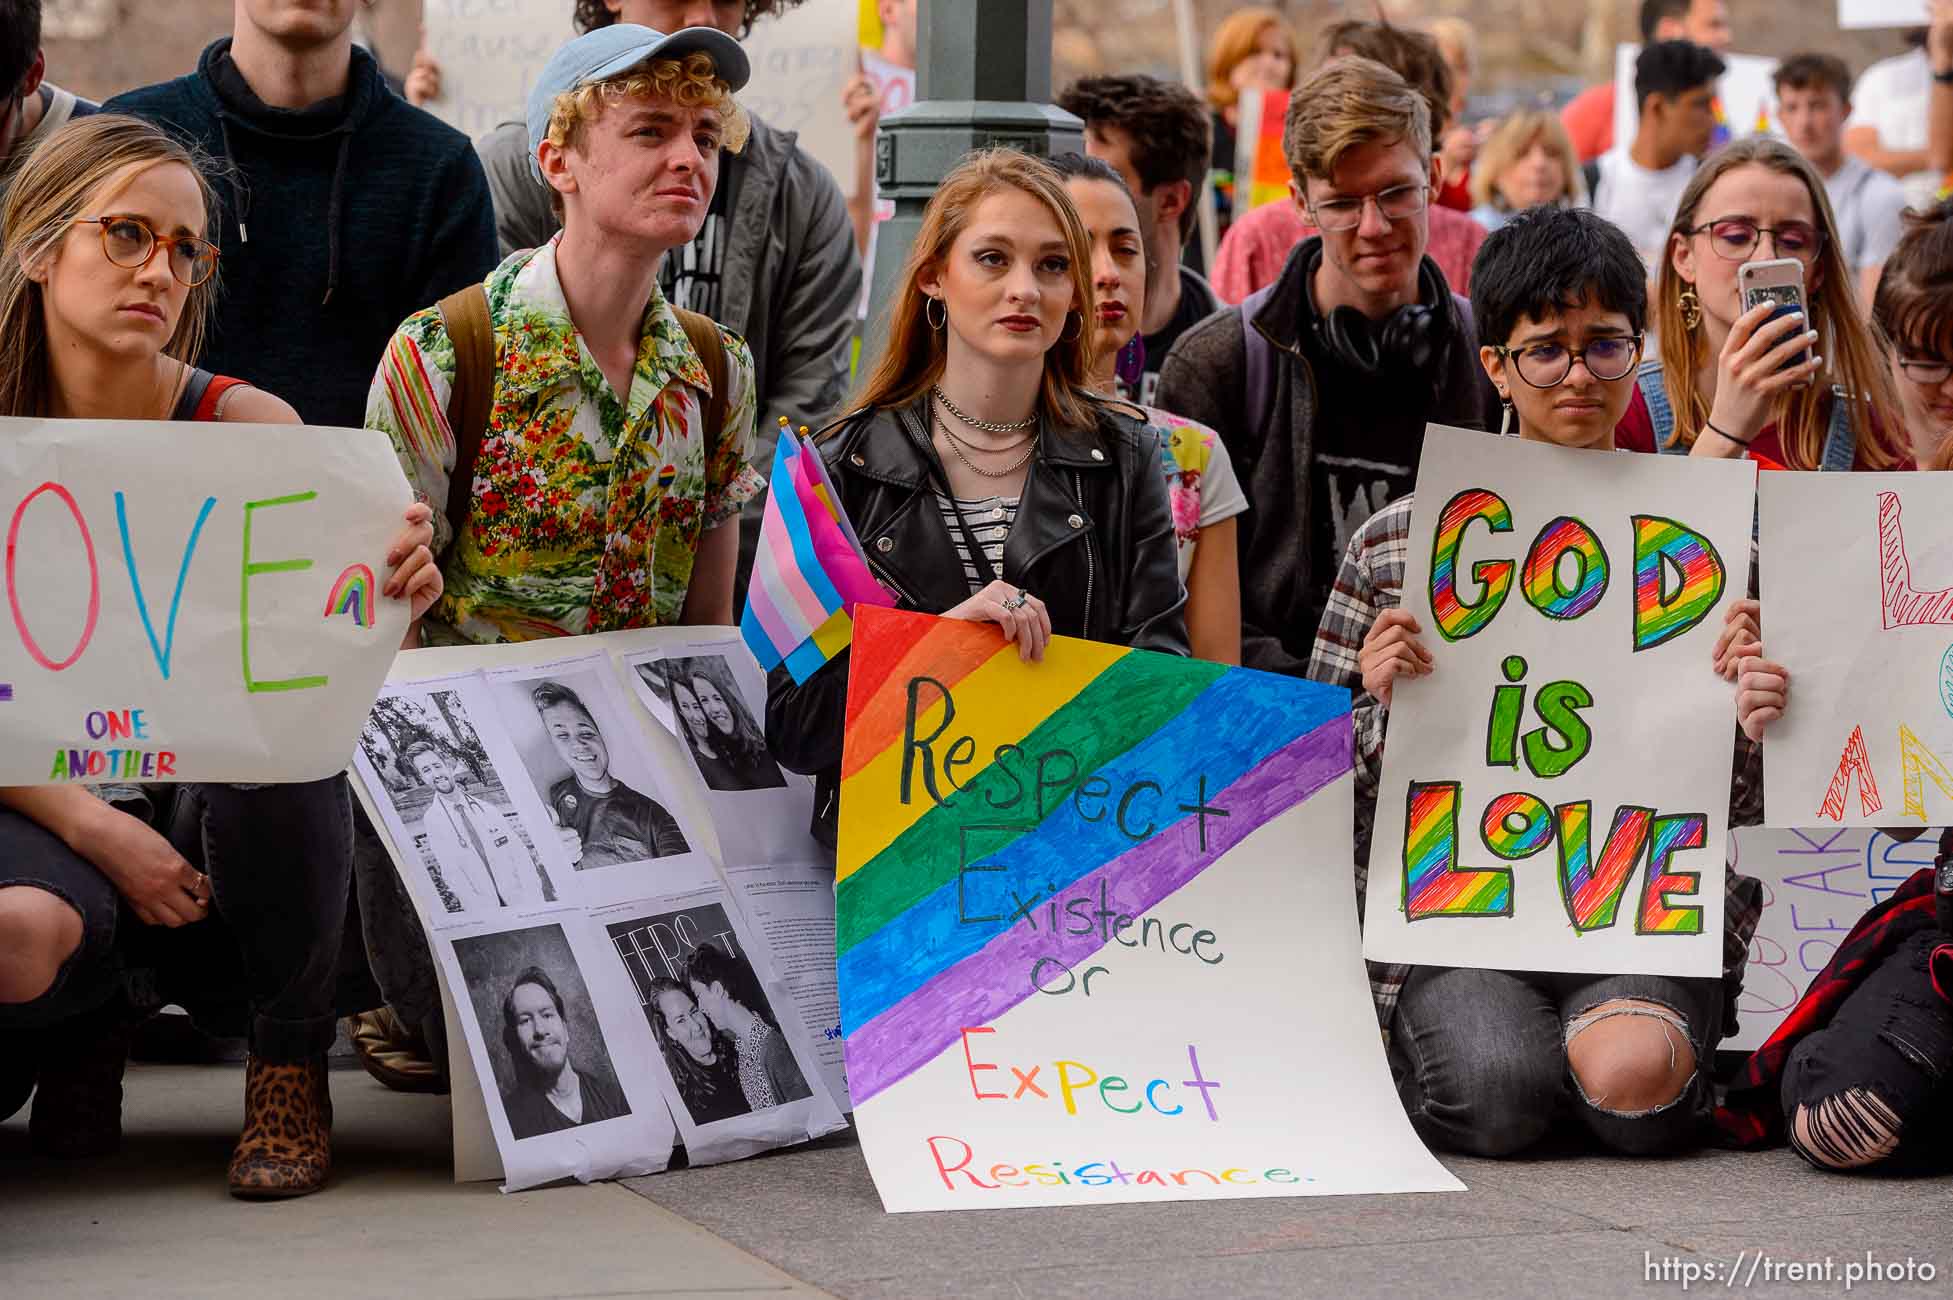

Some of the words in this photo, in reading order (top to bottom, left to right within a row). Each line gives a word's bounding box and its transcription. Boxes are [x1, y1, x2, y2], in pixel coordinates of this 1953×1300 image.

[0, 481, 329, 703] OVE
[1428, 488, 1726, 652] GOD
[50, 749, 176, 781] ANOTHER
[86, 708, 150, 742] ONE
[900, 676, 1230, 852] Respect
[1485, 655, 1594, 778] is
[959, 824, 1224, 966] Existence
[1400, 779, 1708, 936] LOVE
[961, 1026, 1222, 1122] Expect
[927, 1135, 1317, 1192] Resistance.
